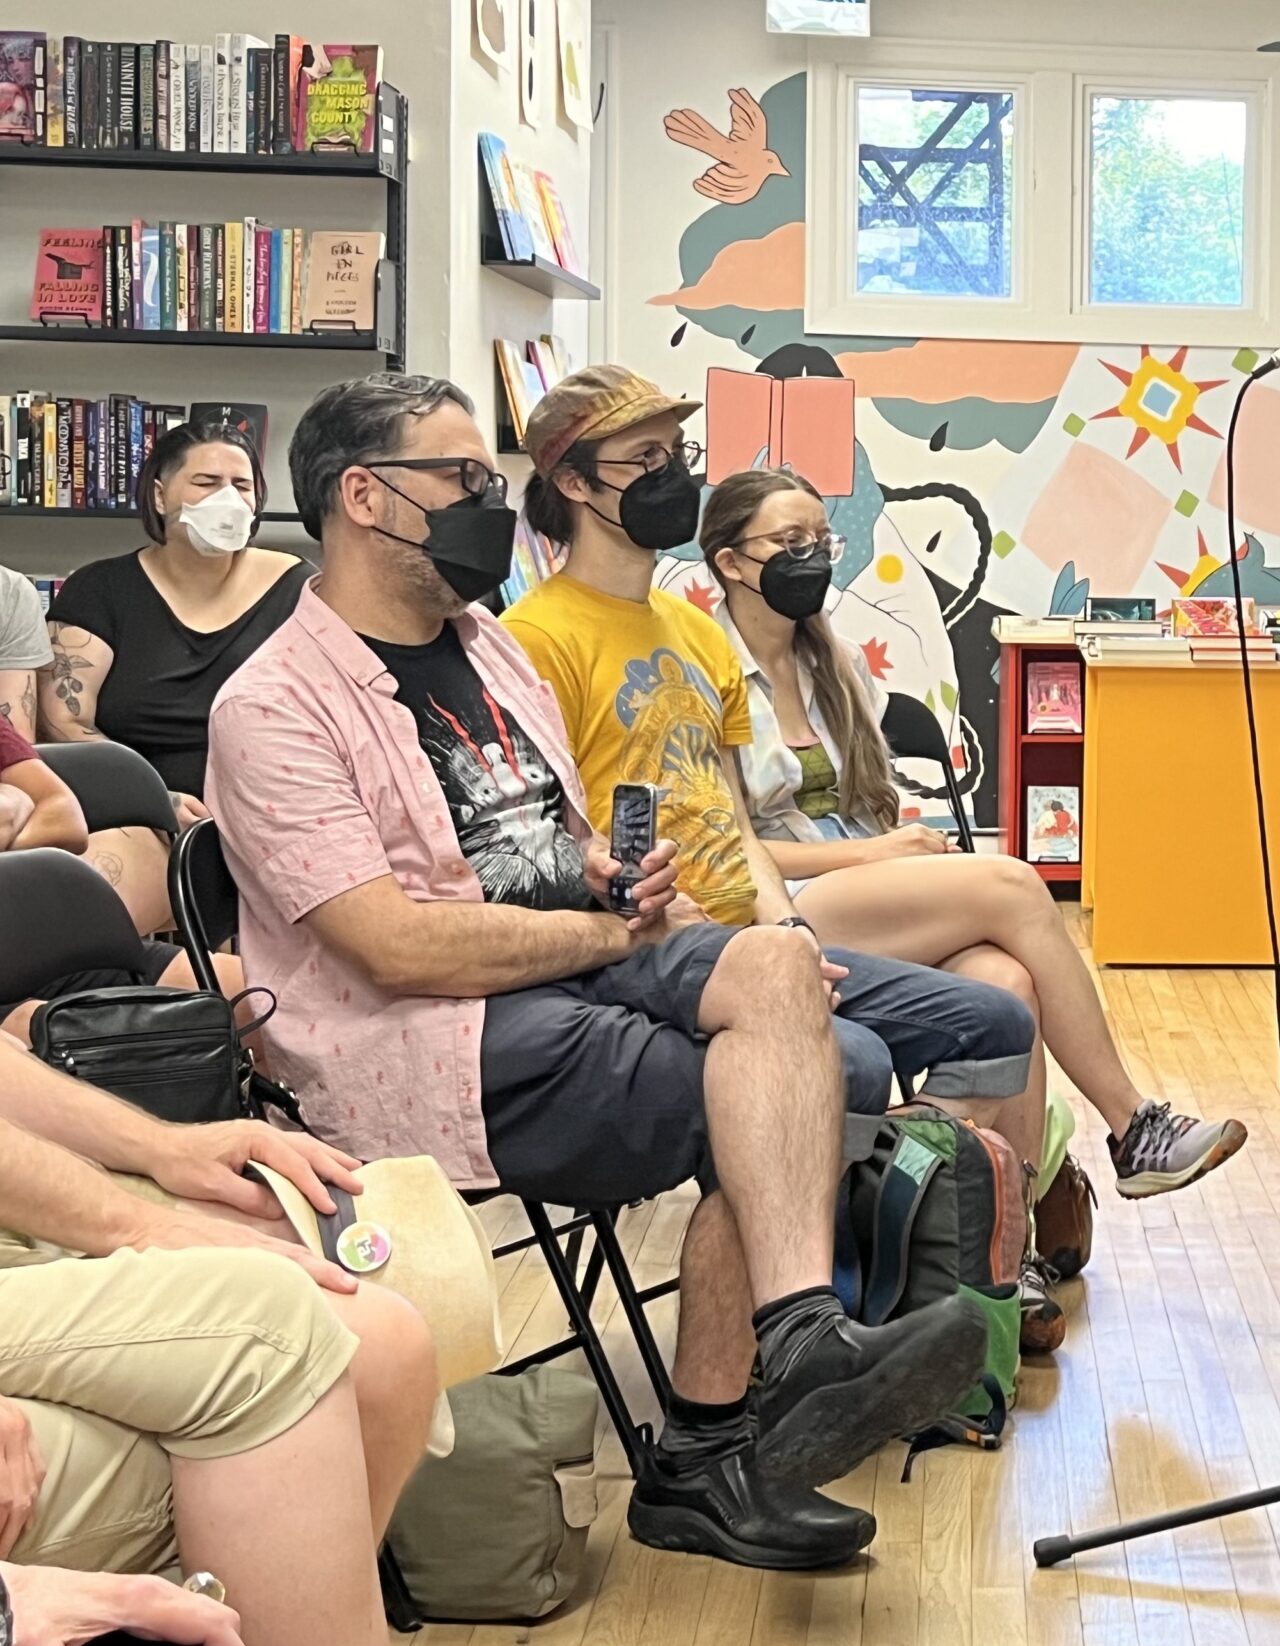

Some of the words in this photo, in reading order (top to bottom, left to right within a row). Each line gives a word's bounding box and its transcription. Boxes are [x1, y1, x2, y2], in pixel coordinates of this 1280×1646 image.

[120, 61, 134, 95] NINTH
[307, 83, 367, 97] DRAGGING
[326, 96, 369, 110] MASON
[120, 97, 134, 132] HOUSE
[311, 109, 357, 124] COUNTY
[43, 236, 104, 249] FEELING
[39, 283, 99, 294] FALLING
[38, 293, 53, 304] IN
[58, 293, 97, 304] LOVE
